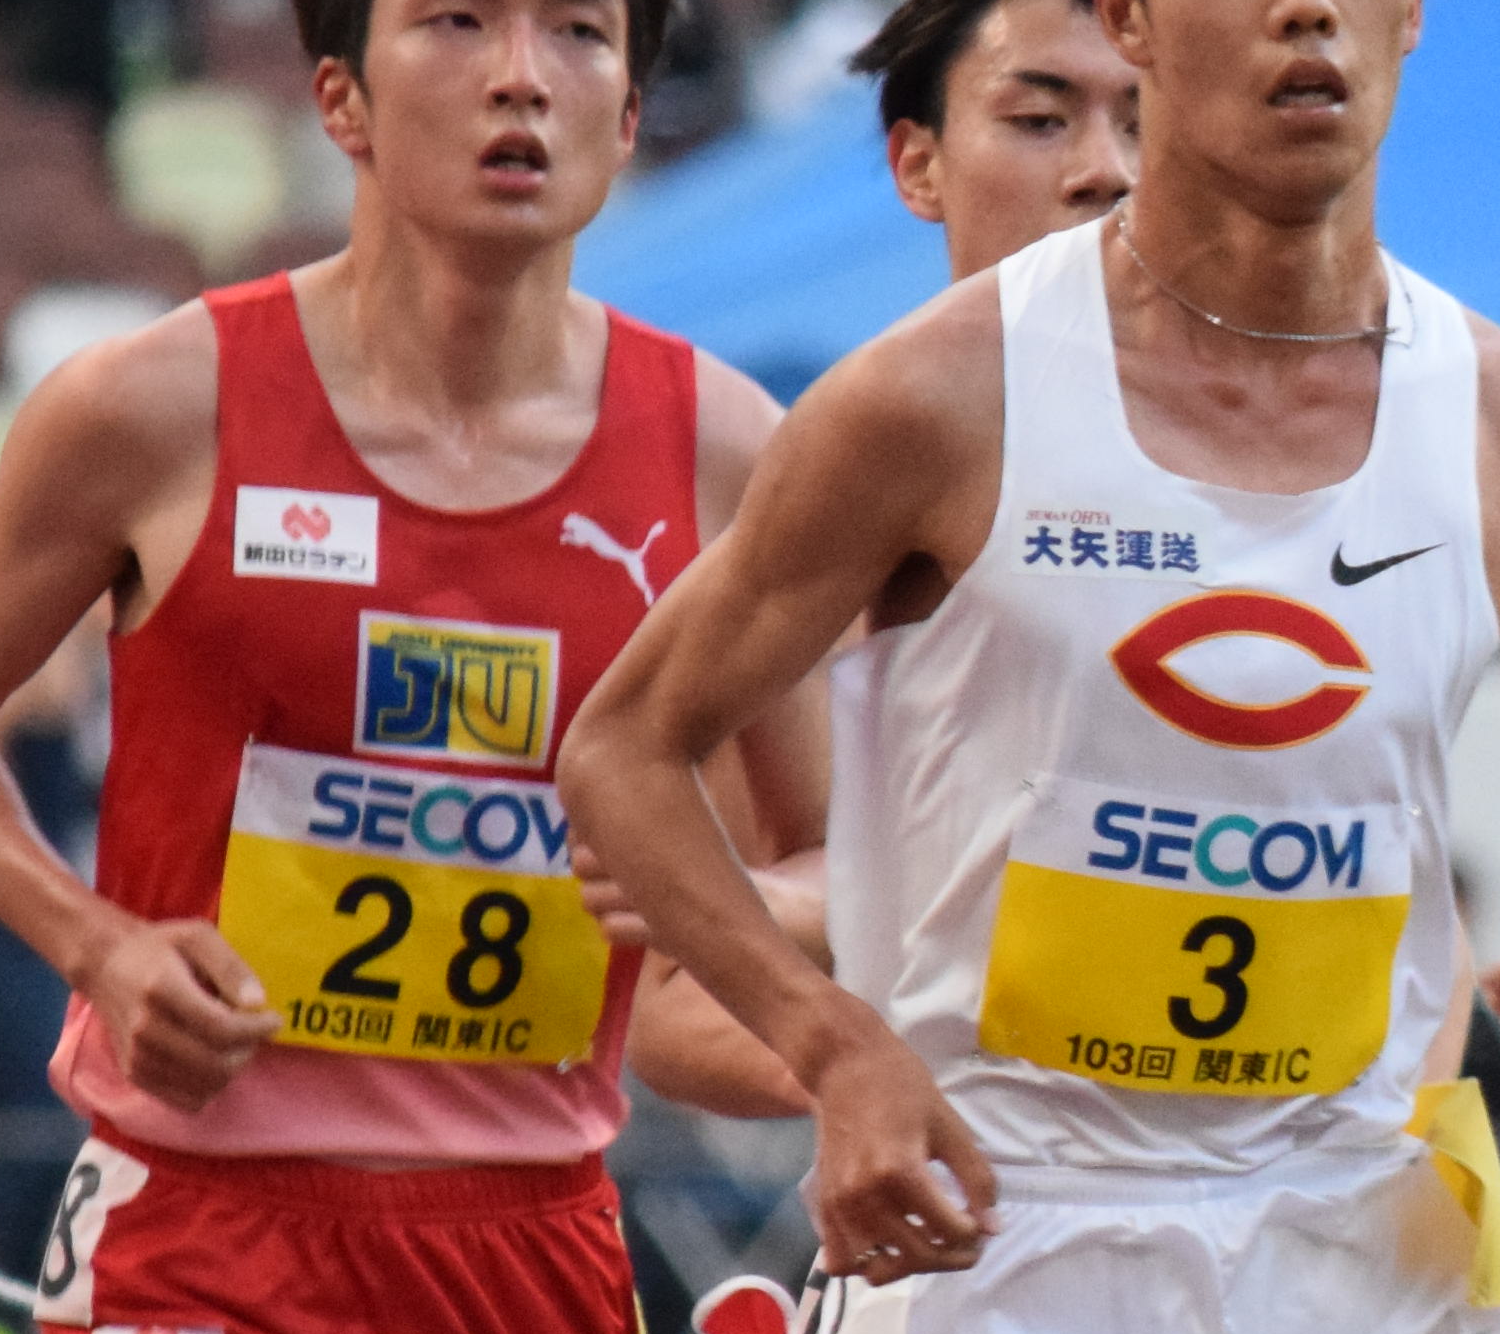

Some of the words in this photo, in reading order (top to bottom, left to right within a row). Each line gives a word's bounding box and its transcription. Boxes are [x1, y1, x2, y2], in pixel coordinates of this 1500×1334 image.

[1023, 525, 1200, 573] 大矢運送
[1088, 800, 1366, 893] SECOM
[320, 874, 531, 1009] 28
[1167, 915, 1257, 1041] 3
[286, 997, 394, 1045] 103回
[409, 1012, 533, 1055] 関東IC
[1065, 1033, 1178, 1082] 103回
[1192, 1046, 1313, 1085] 関東IC
